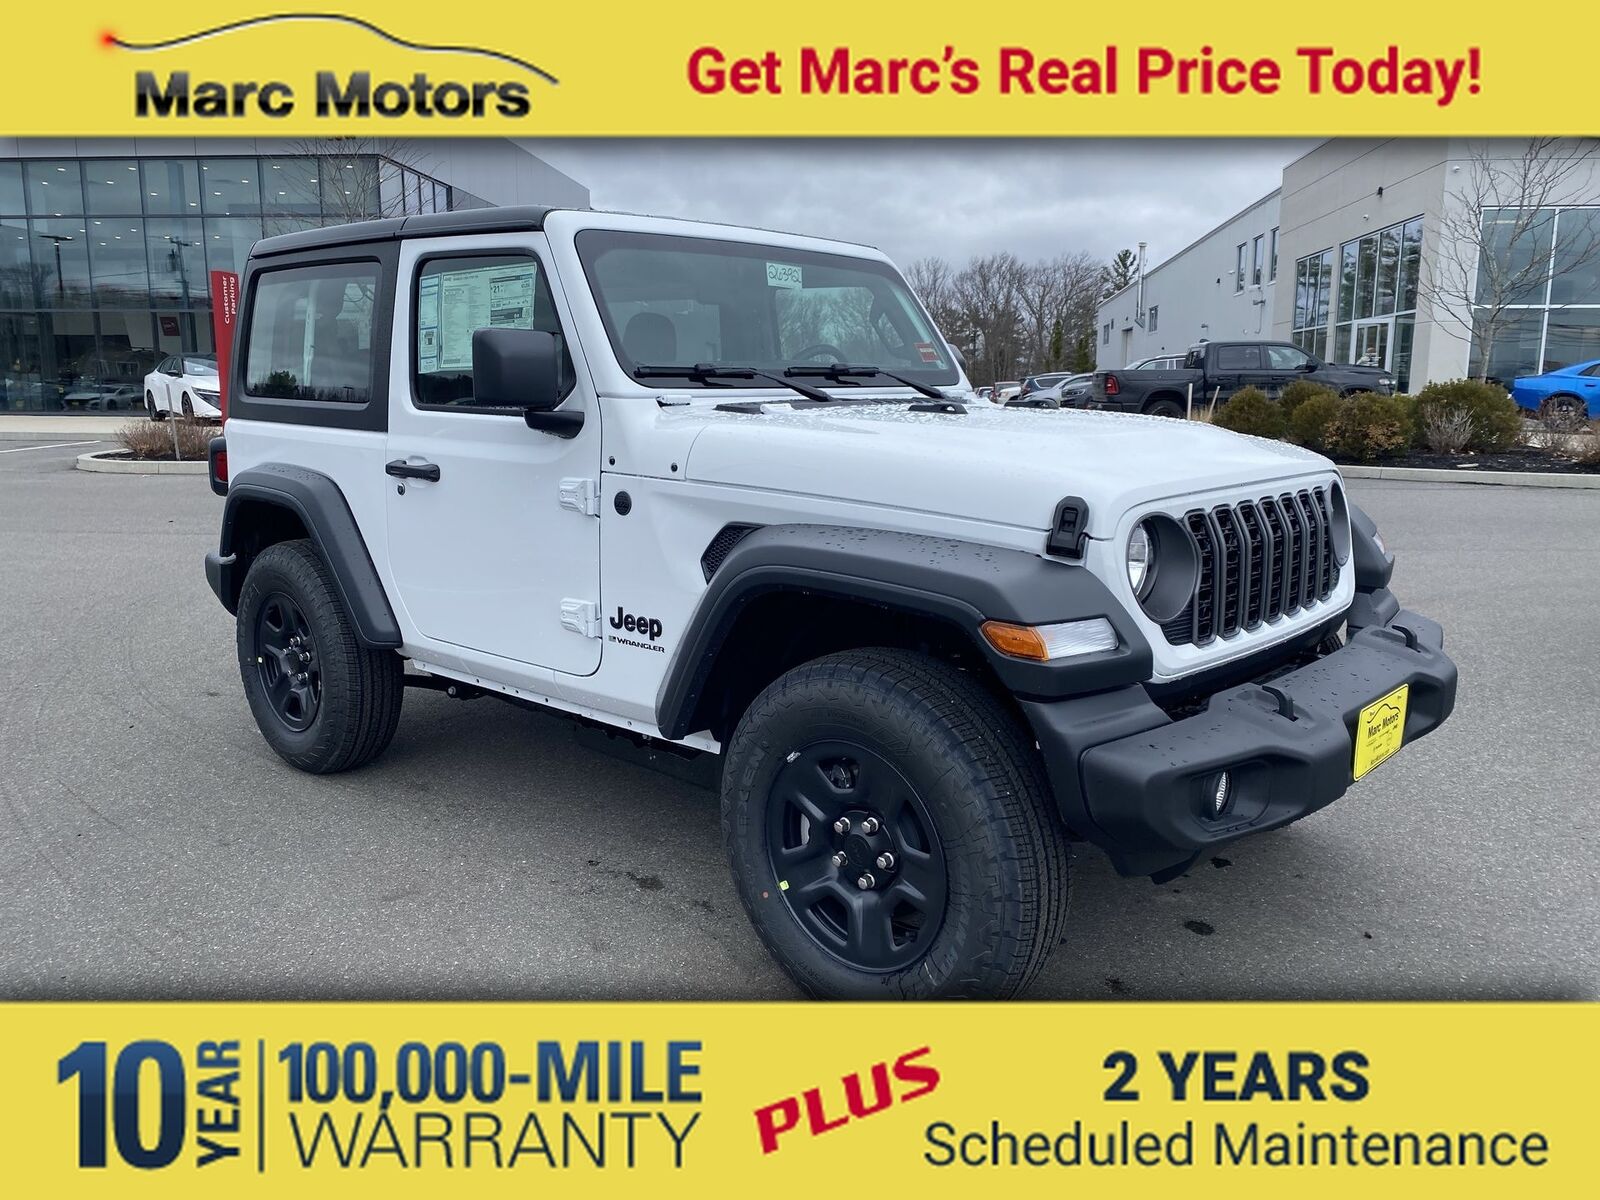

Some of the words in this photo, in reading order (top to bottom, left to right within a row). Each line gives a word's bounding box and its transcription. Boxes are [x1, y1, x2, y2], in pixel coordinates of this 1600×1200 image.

[222, 276, 230, 324] Customer
[609, 606, 663, 641] Jeep
[616, 636, 665, 653] WRANGLER
[1367, 723, 1382, 739] Marc
[1381, 712, 1399, 729] Motors
